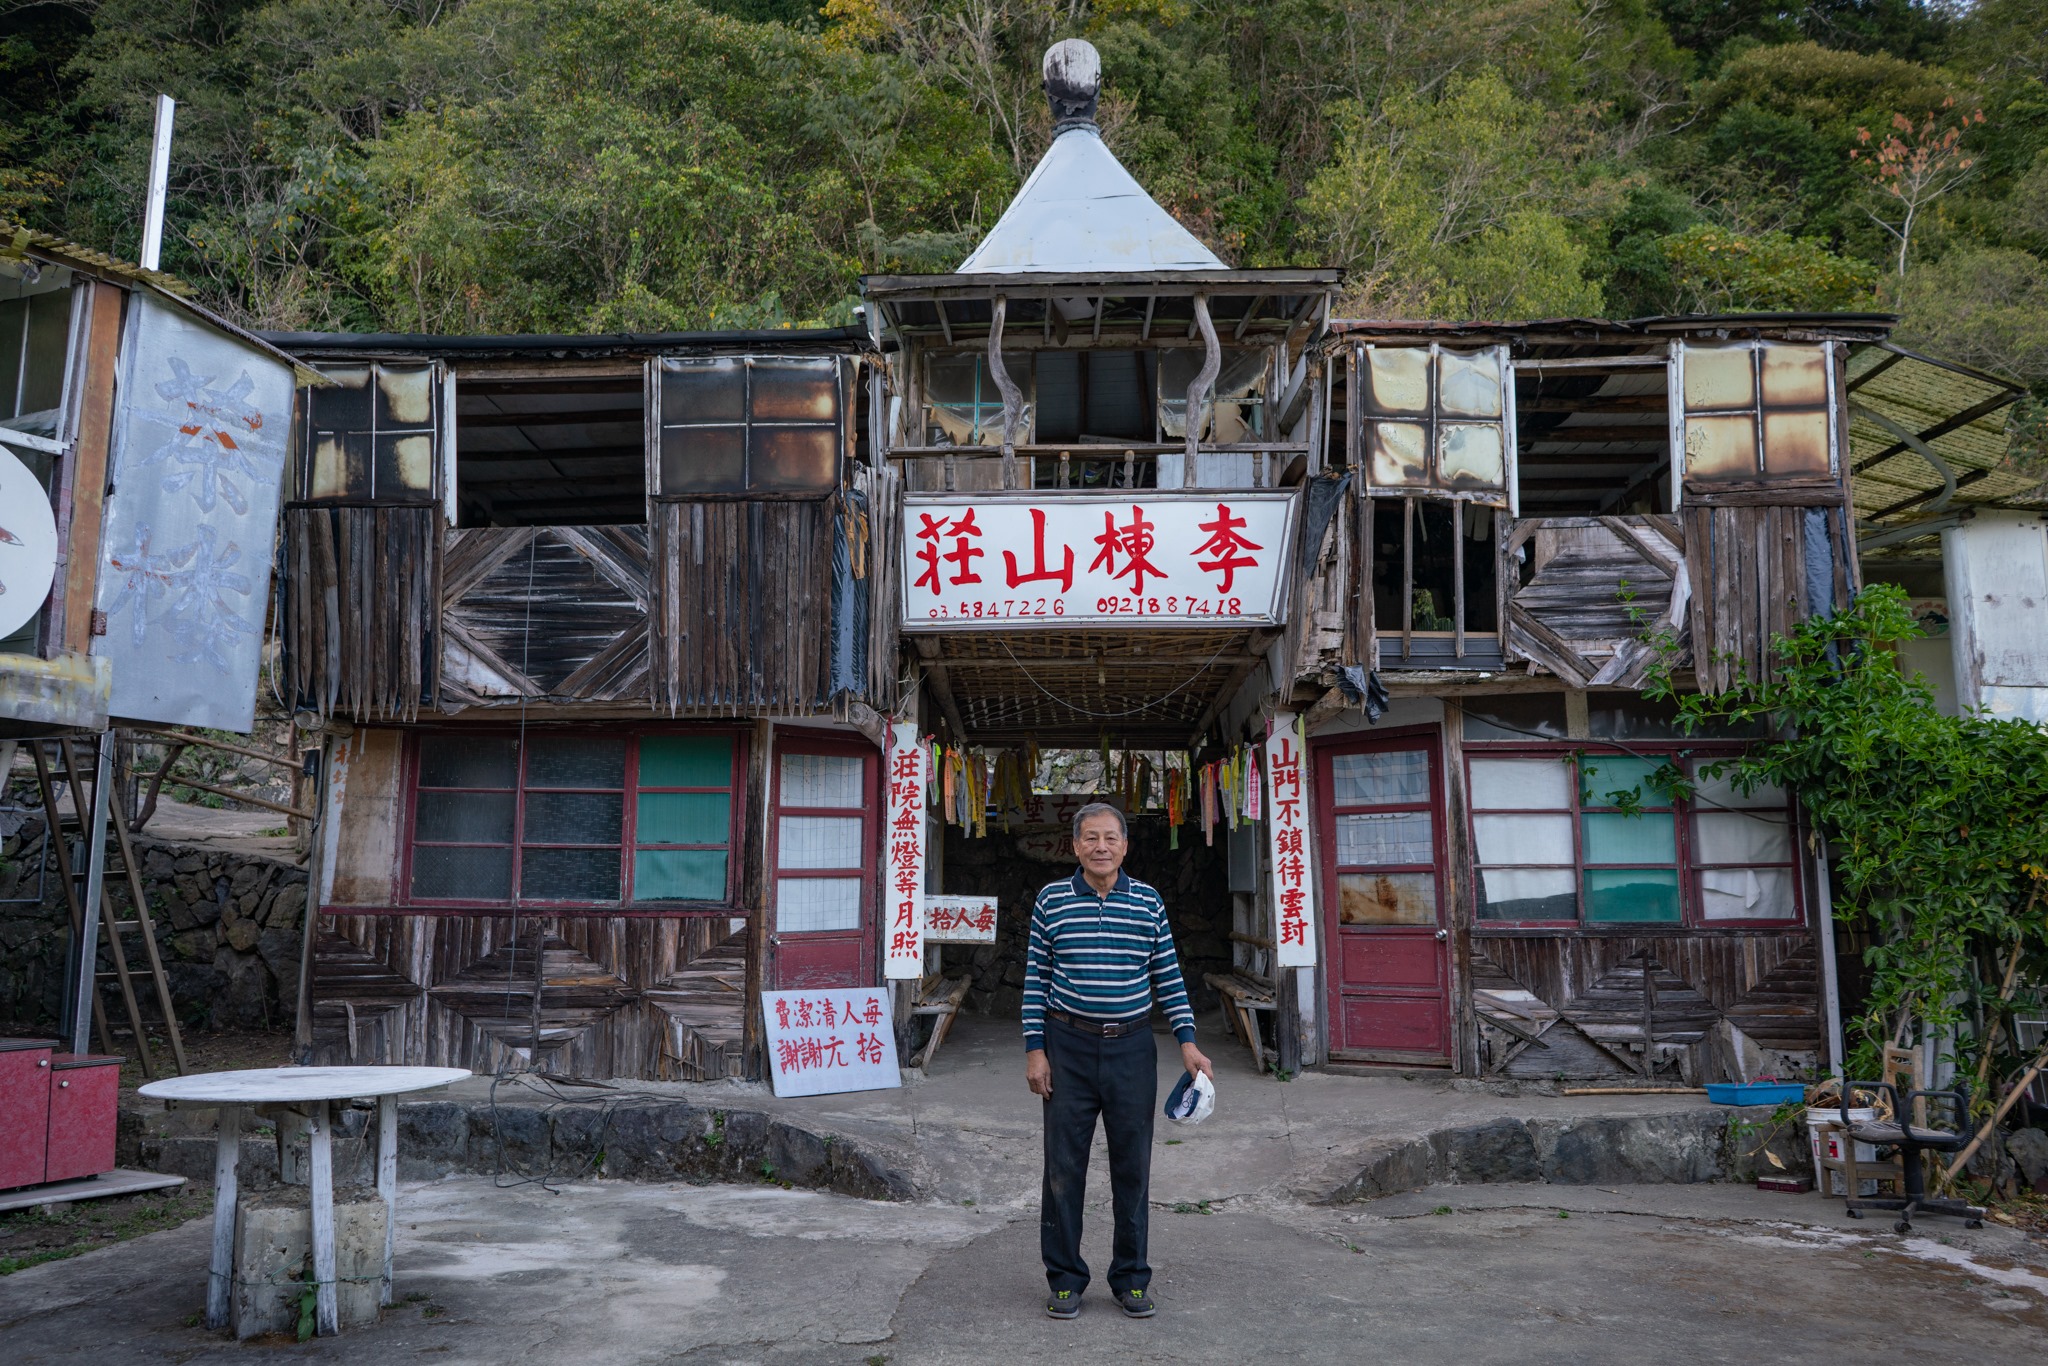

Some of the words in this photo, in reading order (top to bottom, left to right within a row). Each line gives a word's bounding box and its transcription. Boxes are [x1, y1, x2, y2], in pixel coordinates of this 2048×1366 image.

[913, 502, 1264, 596] 李棟山莊
[1096, 595, 1242, 615] 0921887418
[1271, 738, 1309, 947] 山門不鎖待雲封
[924, 904, 997, 933] 每人拾
[775, 996, 884, 1030] 每人清潔費
